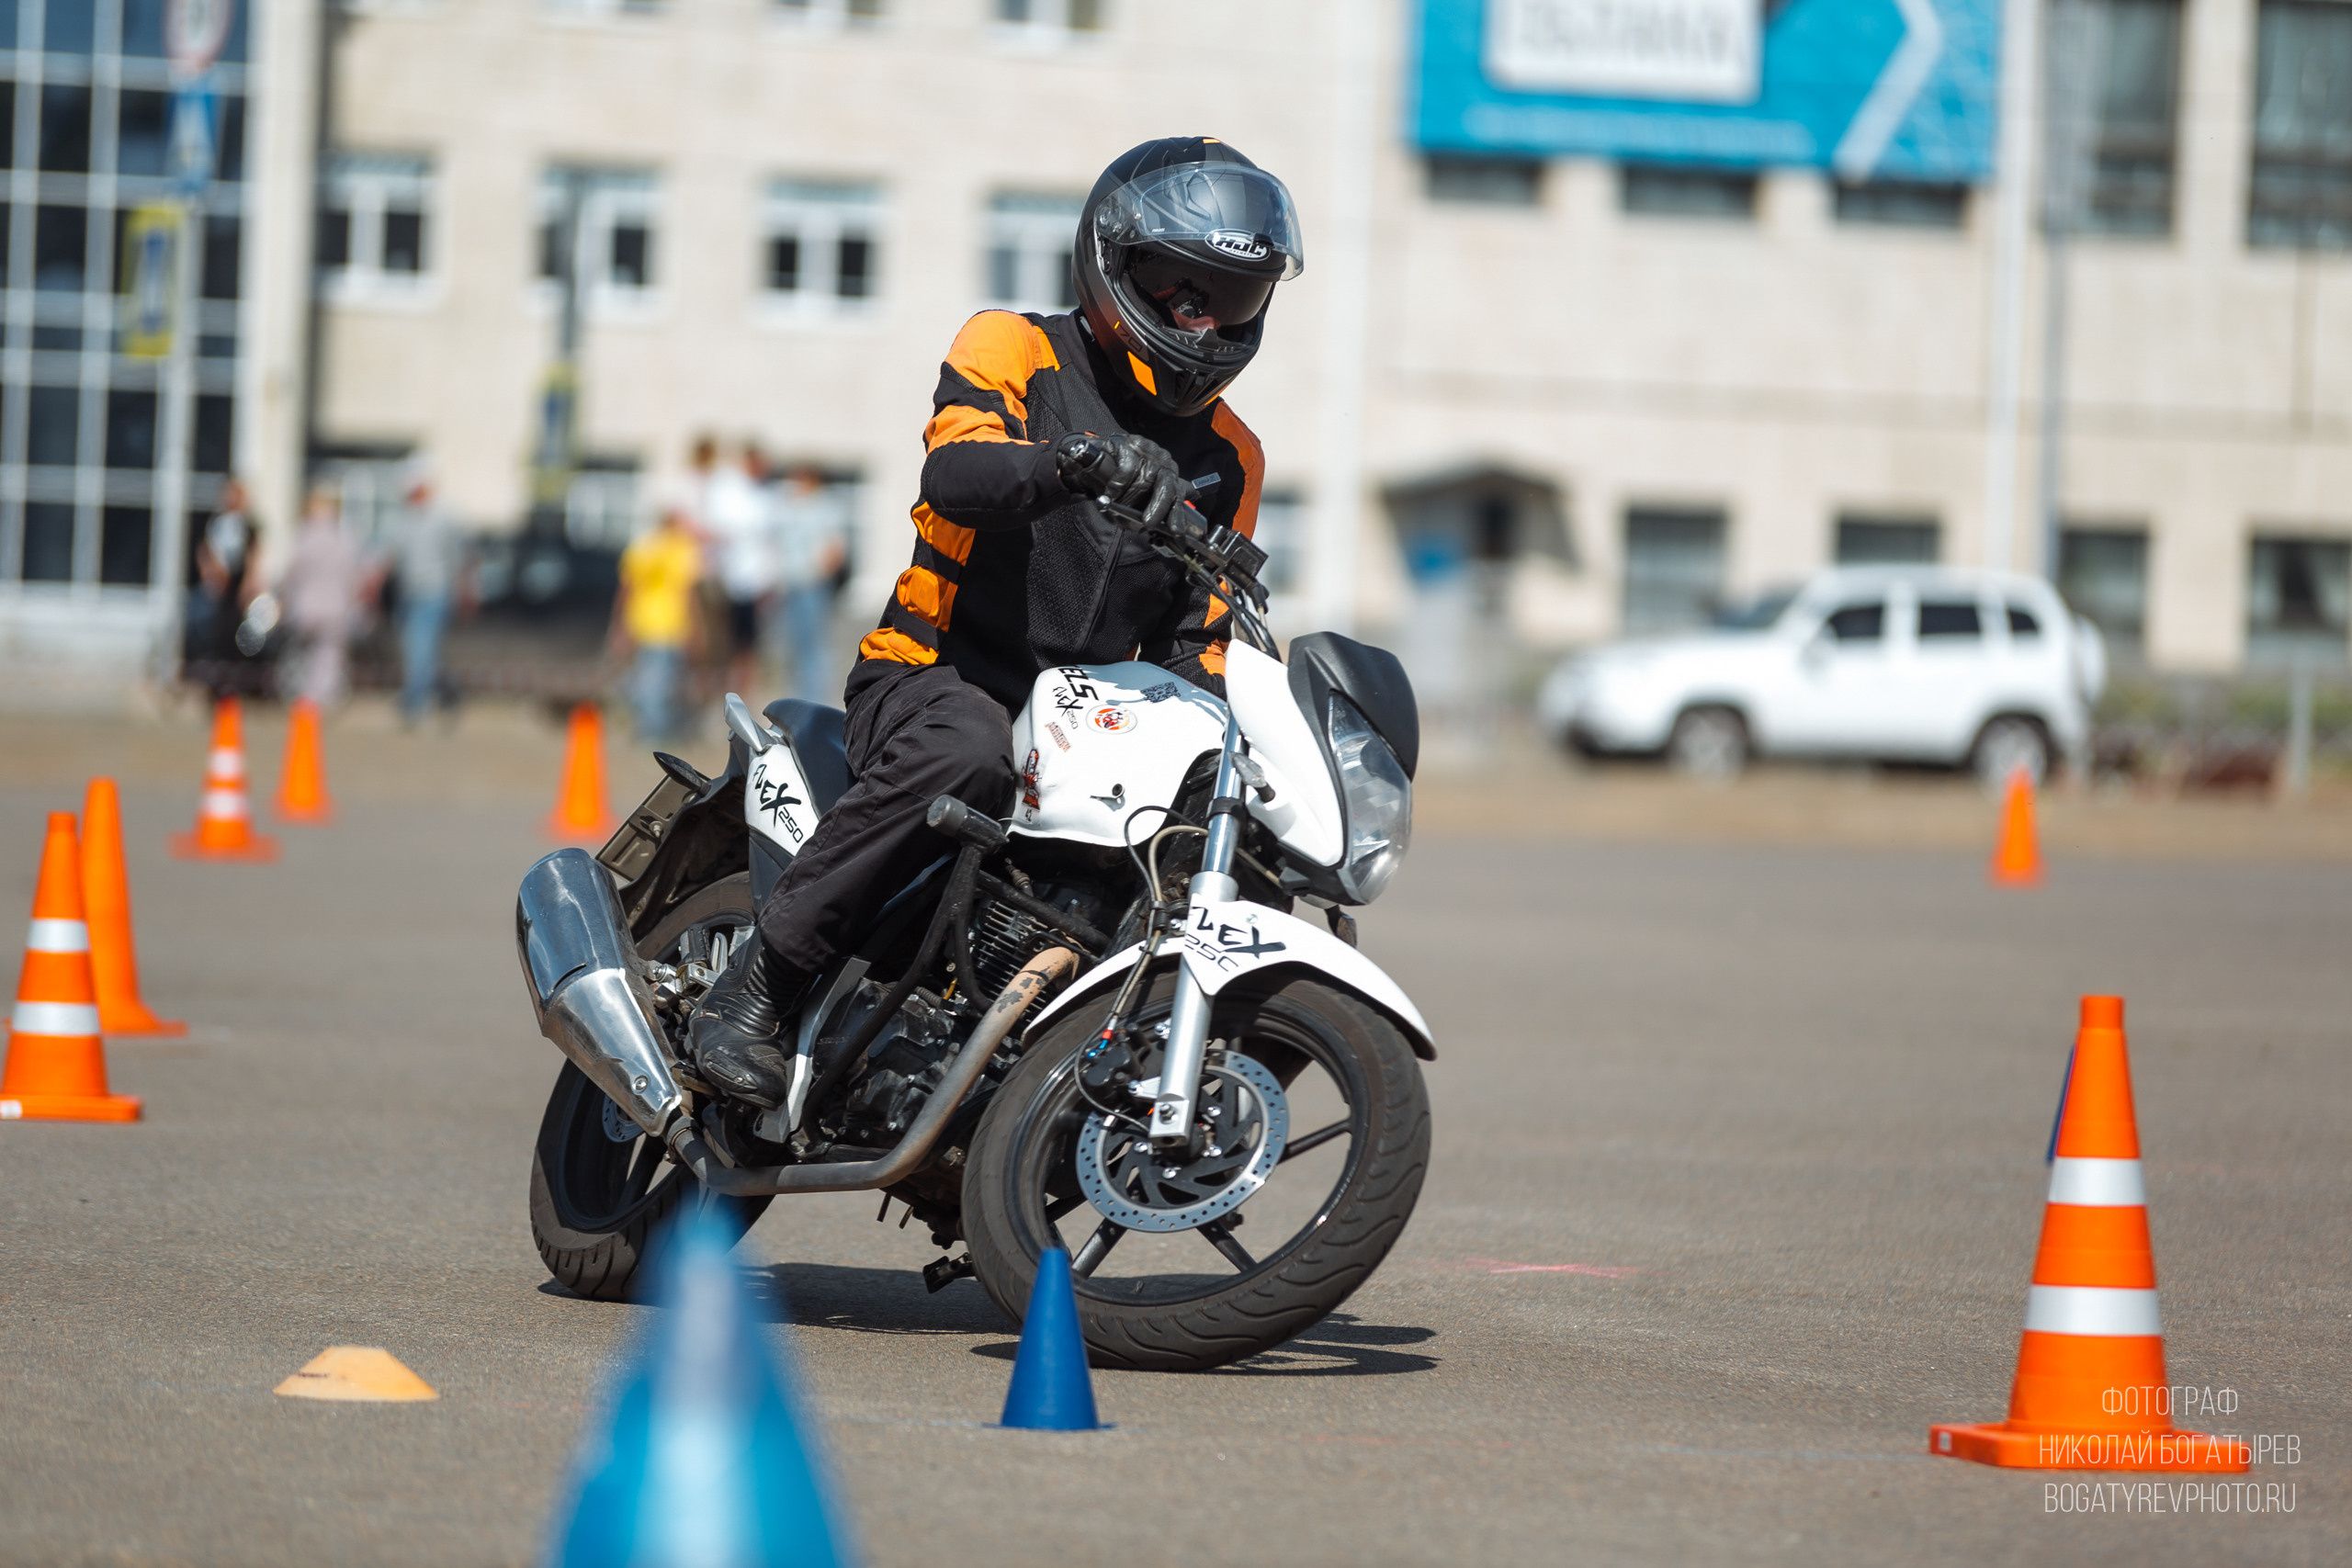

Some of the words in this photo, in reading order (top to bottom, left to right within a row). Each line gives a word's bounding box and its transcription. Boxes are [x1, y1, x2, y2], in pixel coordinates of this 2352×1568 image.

[1215, 236, 1267, 256] HJC
[1057, 665, 1099, 701] ELS
[752, 763, 801, 828] FLEX
[778, 807, 804, 843] 250
